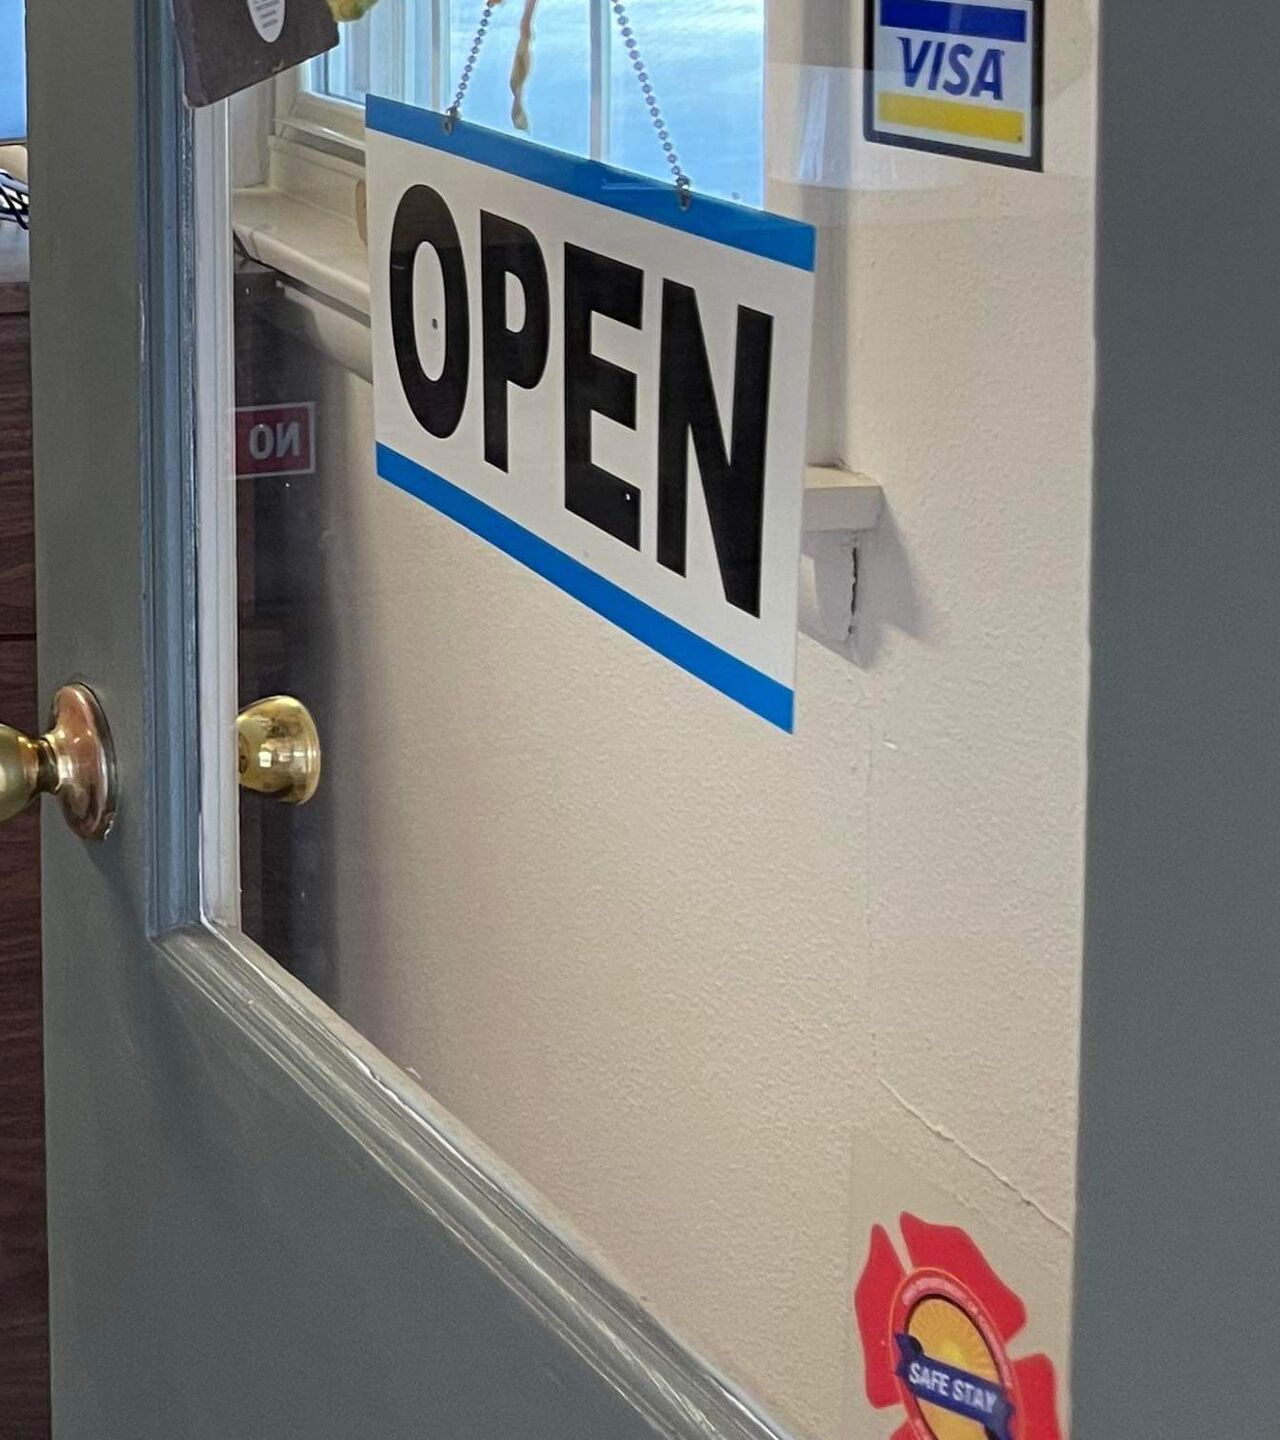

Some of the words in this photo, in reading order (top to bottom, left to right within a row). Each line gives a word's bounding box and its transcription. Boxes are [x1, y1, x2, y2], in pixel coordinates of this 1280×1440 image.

[896, 35, 1006, 102] VISA
[389, 182, 774, 619] OPEN
[908, 1361, 950, 1395] SAFE
[951, 1377, 999, 1414] STAY
